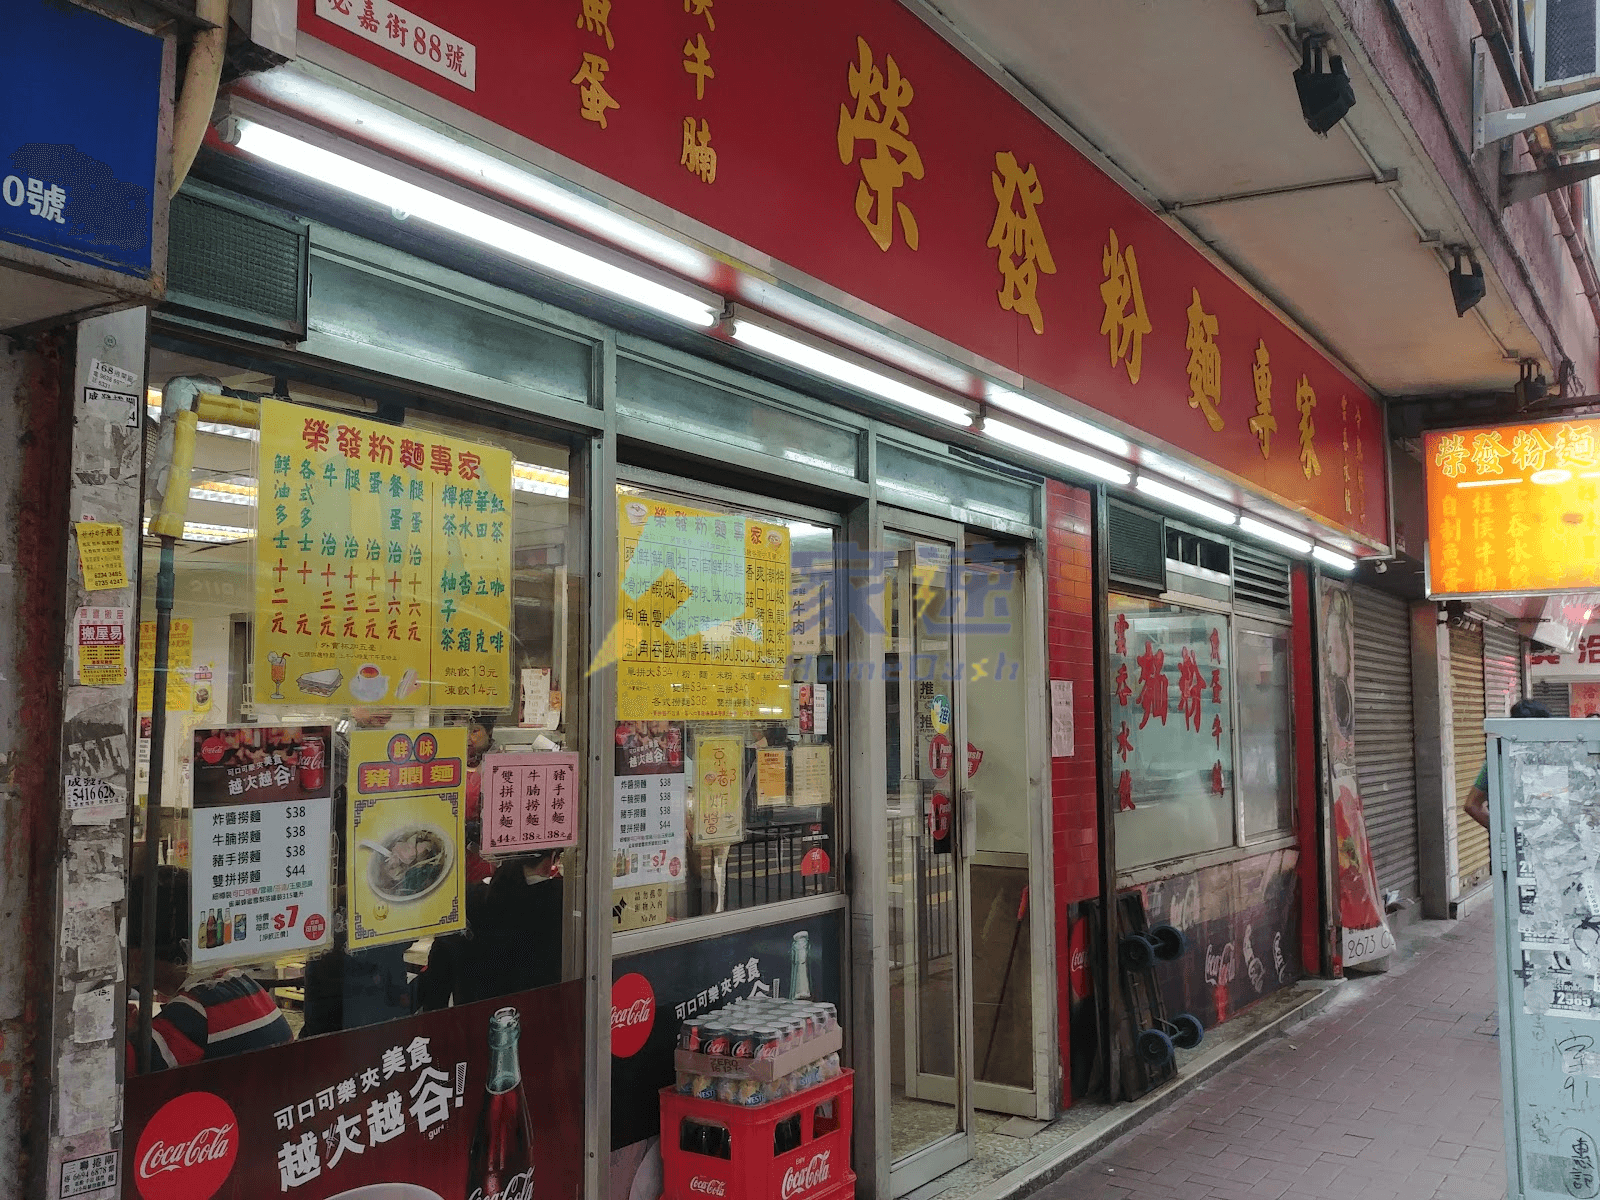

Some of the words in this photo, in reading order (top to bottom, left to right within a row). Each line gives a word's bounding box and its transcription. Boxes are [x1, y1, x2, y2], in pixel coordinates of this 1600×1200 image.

[302, 418, 482, 481] 榮發粉麵專家
[1435, 424, 1597, 478] 榮發粉麵
[81, 625, 122, 641] 搬屋易
[919, 681, 935, 695] 推
[392, 740, 434, 759] 鮮味
[226, 754, 283, 776] 可口可樂夾美食
[659, 777, 671, 787] $38
[498, 769, 515, 829] 雙拼撈麵
[524, 768, 541, 827] 牛腩撈麵
[550, 768, 567, 824] 豬手撈麵
[659, 792, 671, 802] $38
[212, 810, 261, 827] 炸醬撈麵
[285, 806, 306, 819] $38
[659, 806, 671, 816] $38
[546, 830, 567, 839] 38元
[659, 819, 671, 830] $44
[212, 829, 261, 847] 牛腩撈麵
[285, 826, 306, 839] $38
[496, 833, 516, 843] 44元
[522, 831, 542, 841] 38元
[212, 849, 261, 868] 豬手撈麵
[285, 845, 306, 858] $38
[652, 849, 668, 867] $7
[211, 869, 261, 889] 雙拼撈麵
[285, 864, 306, 878] $44
[273, 904, 299, 931] $7
[674, 956, 761, 1021] 可口可樂夾美食
[273, 1035, 433, 1131] 可口可樂夾美食
[139, 1123, 235, 1179] Coca-Cola
[781, 1149, 831, 1200] Coca-Cola
[690, 1175, 727, 1197] Coca-Cola
